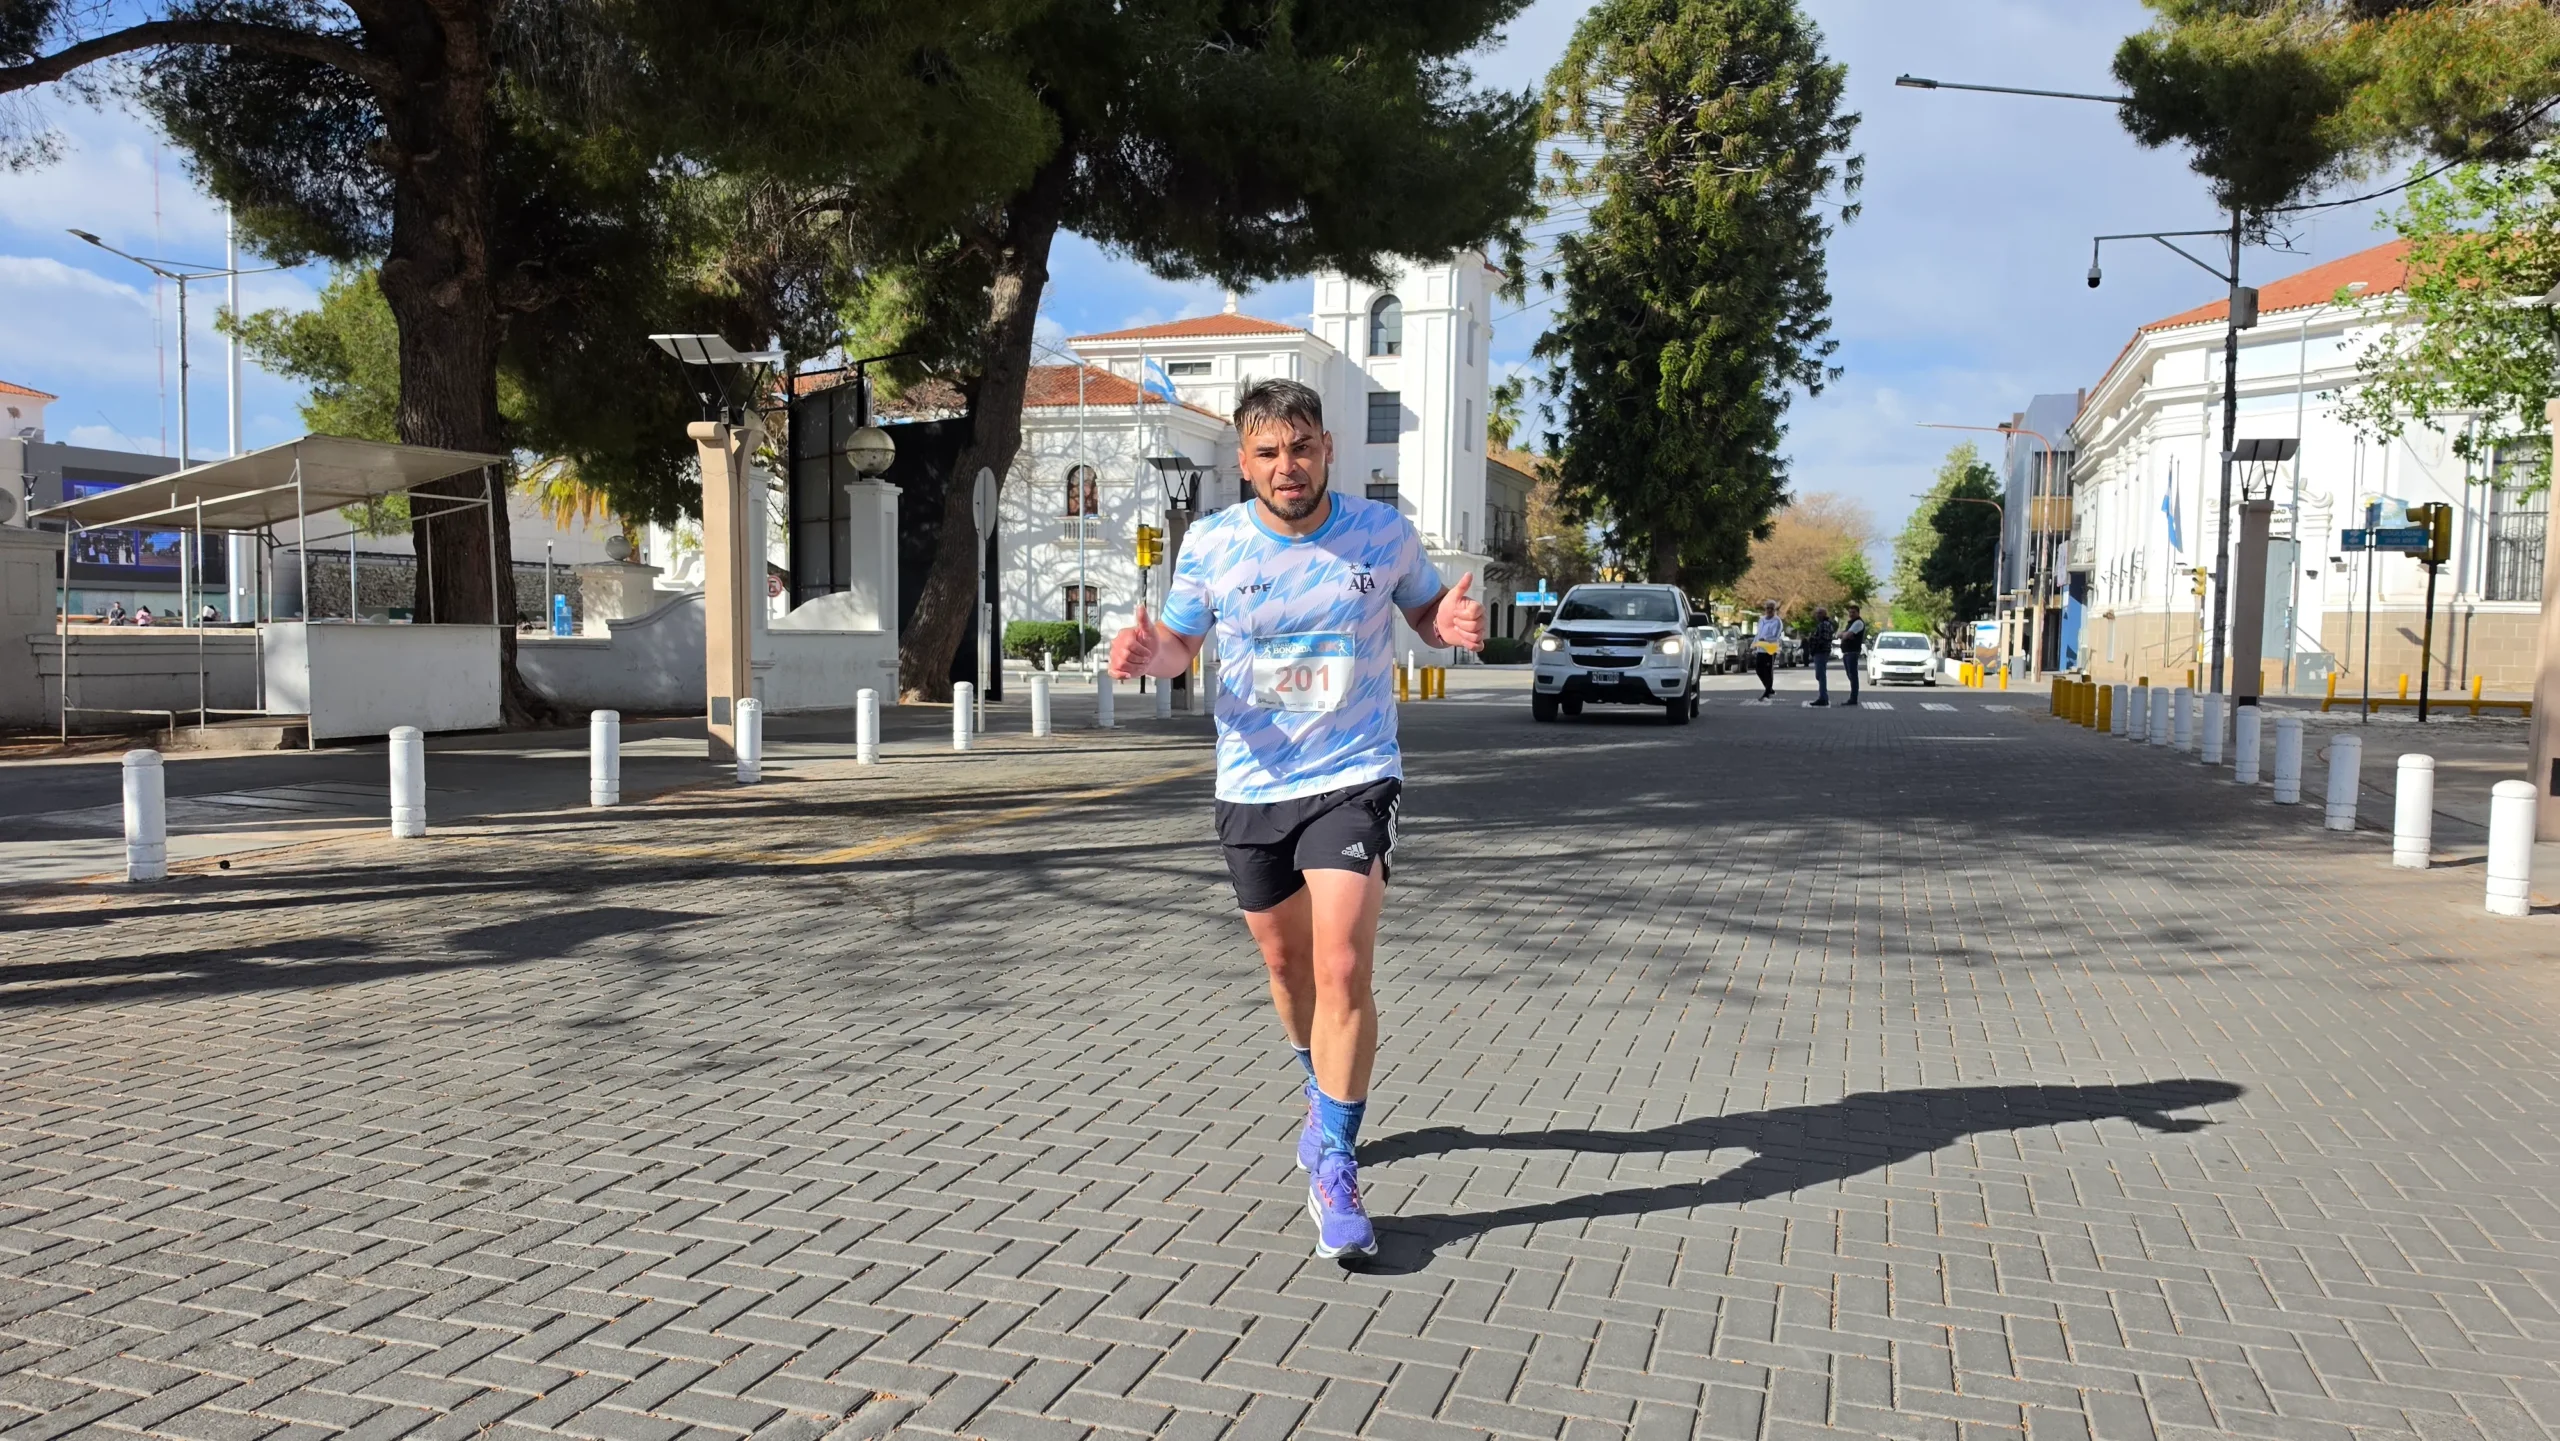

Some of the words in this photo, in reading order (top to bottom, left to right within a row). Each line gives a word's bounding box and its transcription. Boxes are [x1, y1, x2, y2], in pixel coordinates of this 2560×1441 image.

[1237, 583, 1272, 595] YPF
[1348, 571, 1376, 594] AFA
[1274, 664, 1328, 692] 201
